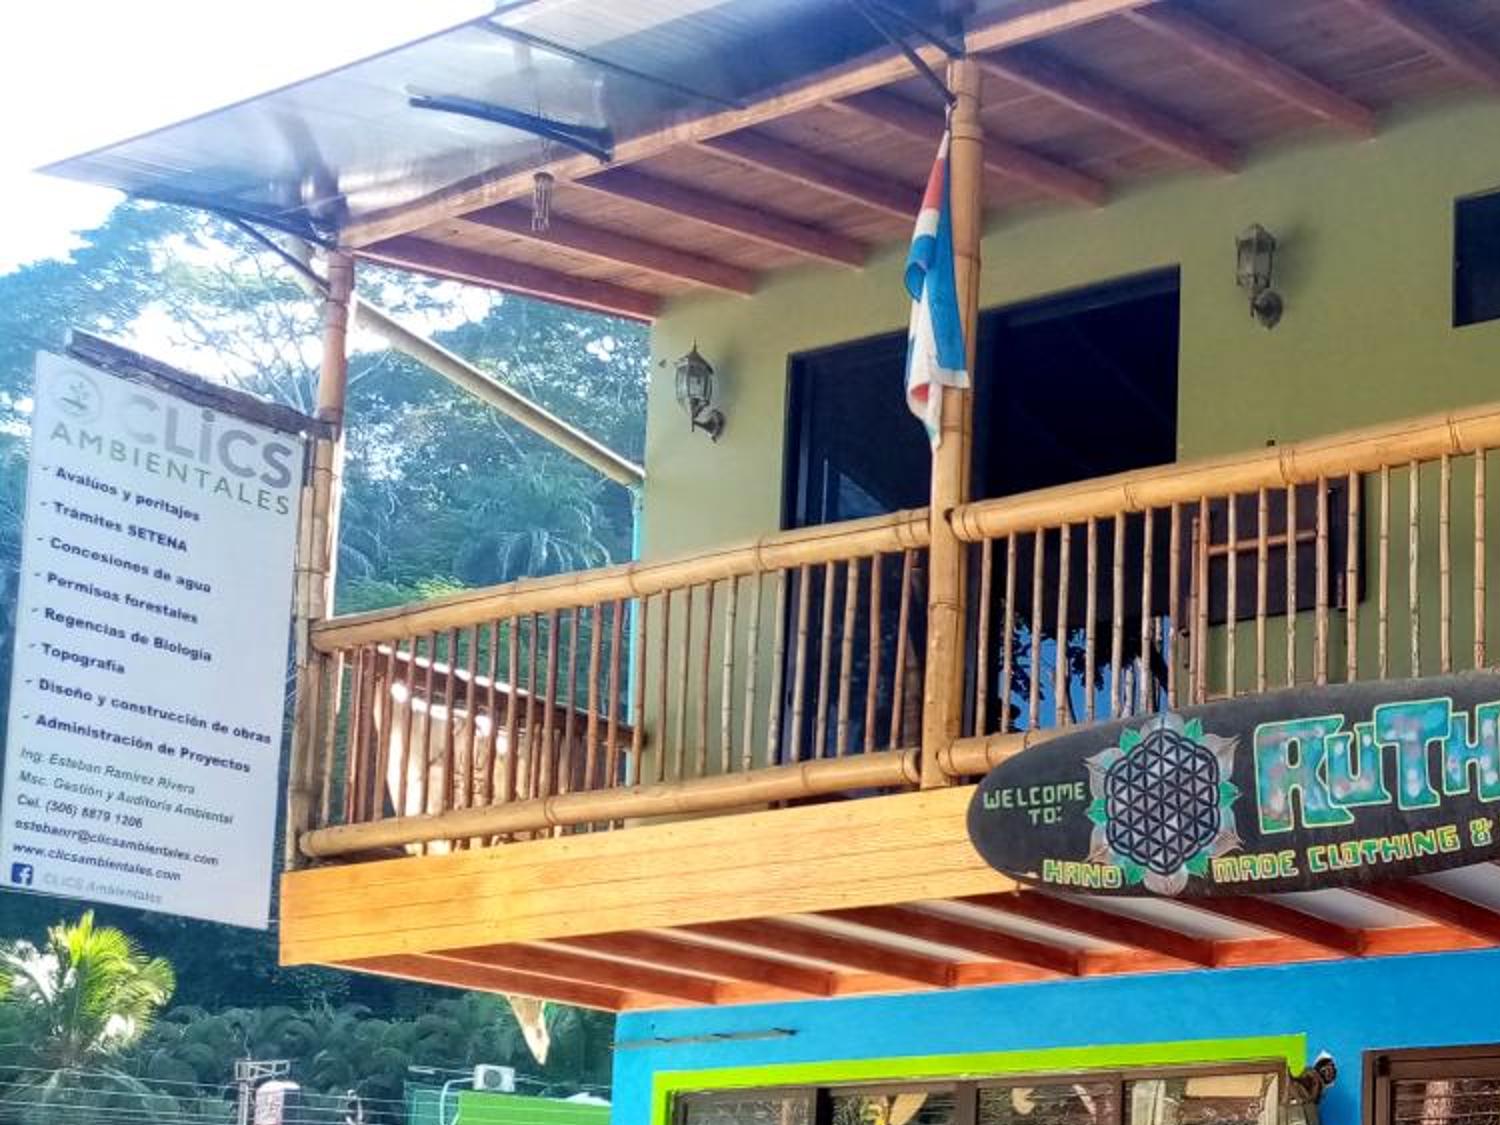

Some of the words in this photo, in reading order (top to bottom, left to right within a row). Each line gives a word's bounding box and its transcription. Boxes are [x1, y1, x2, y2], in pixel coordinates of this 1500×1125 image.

[50, 420, 290, 515] AMBIENTALES
[56, 467, 118, 495] Avalúos
[122, 490, 132, 502] y
[135, 494, 200, 522] peritajes
[127, 524, 188, 552] SETENA
[50, 537, 149, 575] Concesiones
[153, 568, 171, 581] de
[175, 575, 212, 593] agua
[47, 571, 120, 602] Permisos
[125, 593, 198, 624] forestales
[44, 607, 126, 639] Regencias
[131, 632, 149, 644] de
[39, 678, 93, 702] Diseño
[97, 694, 107, 707] y
[111, 698, 207, 729] construcción
[211, 721, 229, 734] de
[233, 726, 272, 744] obras
[36, 714, 153, 751] Administración
[157, 742, 175, 756] de
[180, 747, 251, 773] Proyectos
[49, 753, 102, 774] Esteban
[158, 776, 195, 795] Rivera
[105, 791, 114, 802] y
[983, 781, 1087, 809] WELCOME
[115, 814, 143, 829] 1206
[1028, 807, 1063, 826] TO:
[1042, 859, 1123, 889] HAND
[1212, 850, 1299, 883] MADE
[1307, 824, 1460, 873] CLOTHING
[1469, 817, 1493, 847] &
